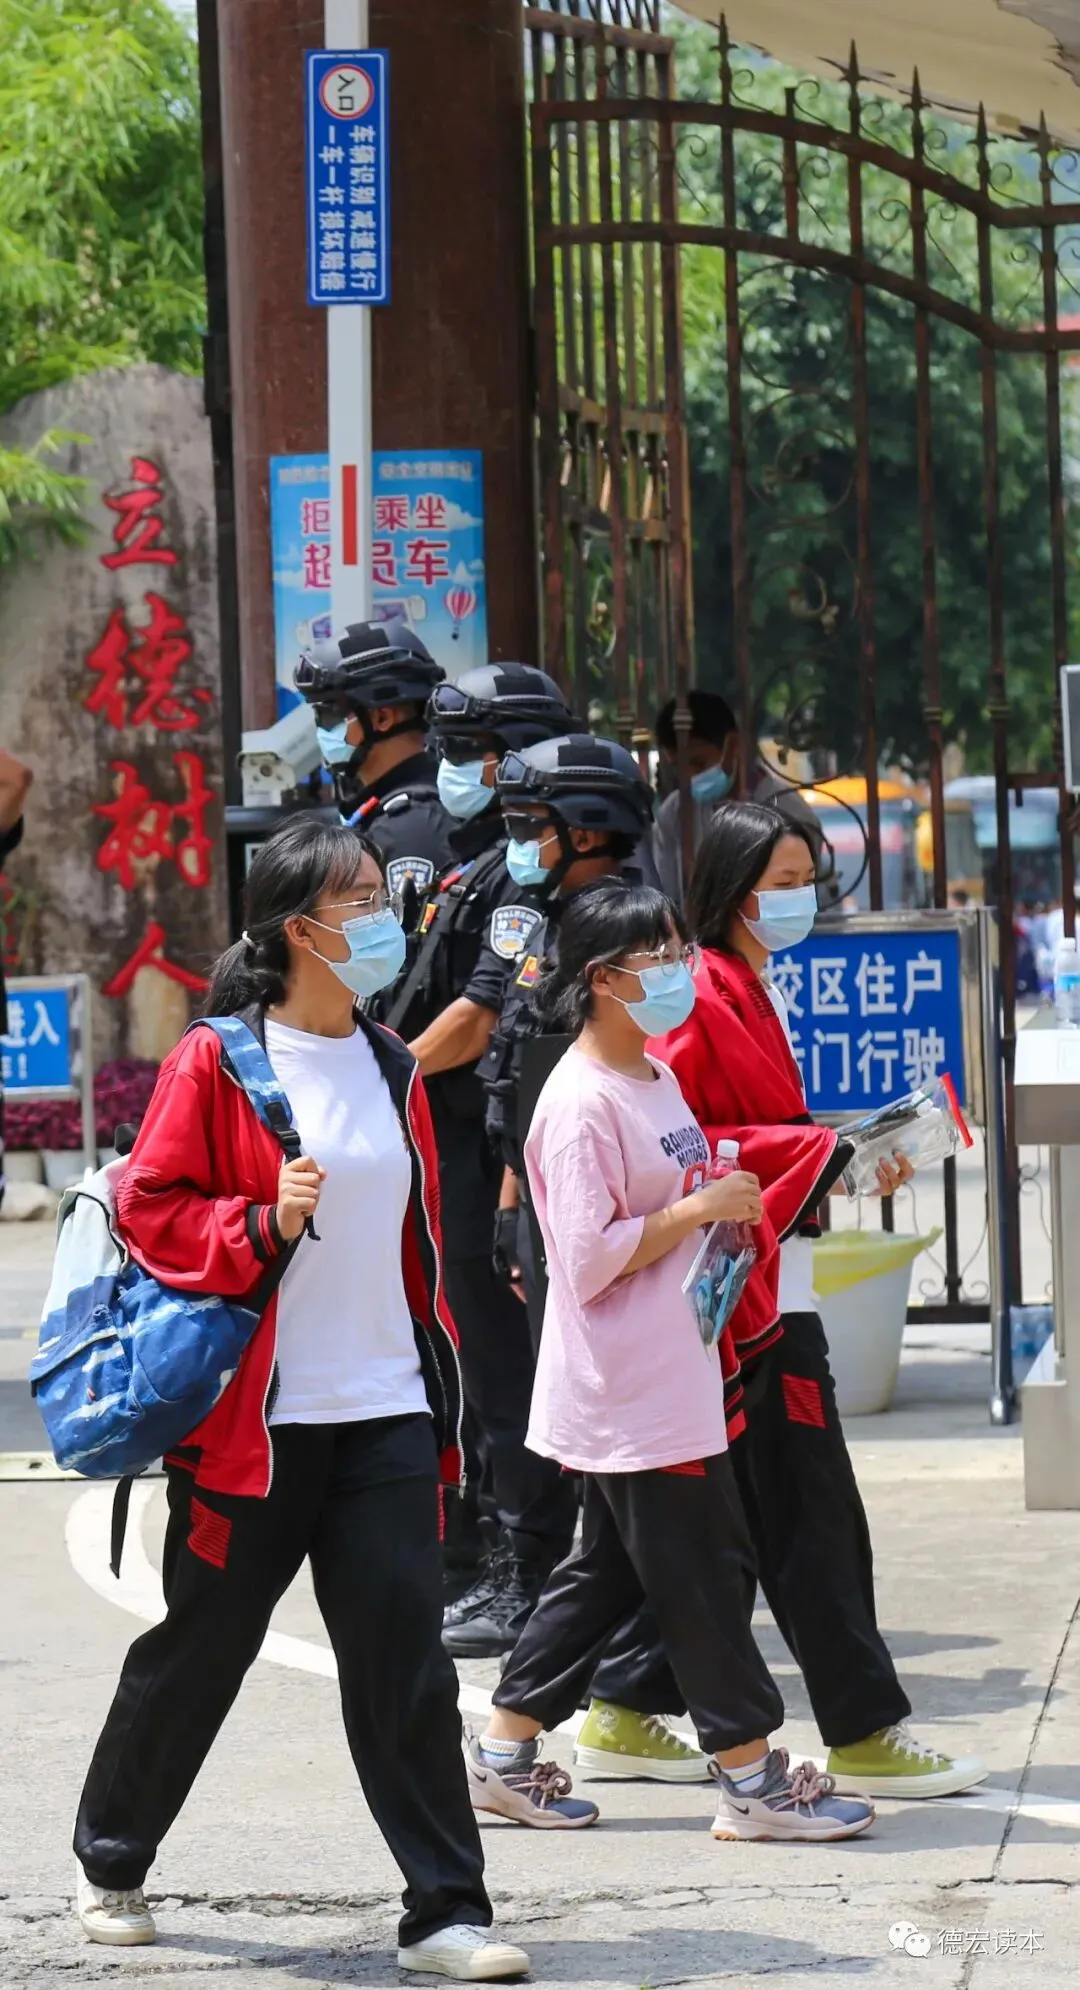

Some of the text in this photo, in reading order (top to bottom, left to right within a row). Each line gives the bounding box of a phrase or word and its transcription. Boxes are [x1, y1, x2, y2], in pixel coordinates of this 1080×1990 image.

[338, 74, 356, 112] 入口
[319, 125, 346, 291] 一车一杆 损坏赔偿
[349, 125, 377, 291] 车辆识别 减速慢行
[303, 495, 447, 533] 拒乘坐
[84, 456, 213, 997] 立德树人
[765, 950, 943, 1019] 校区住户
